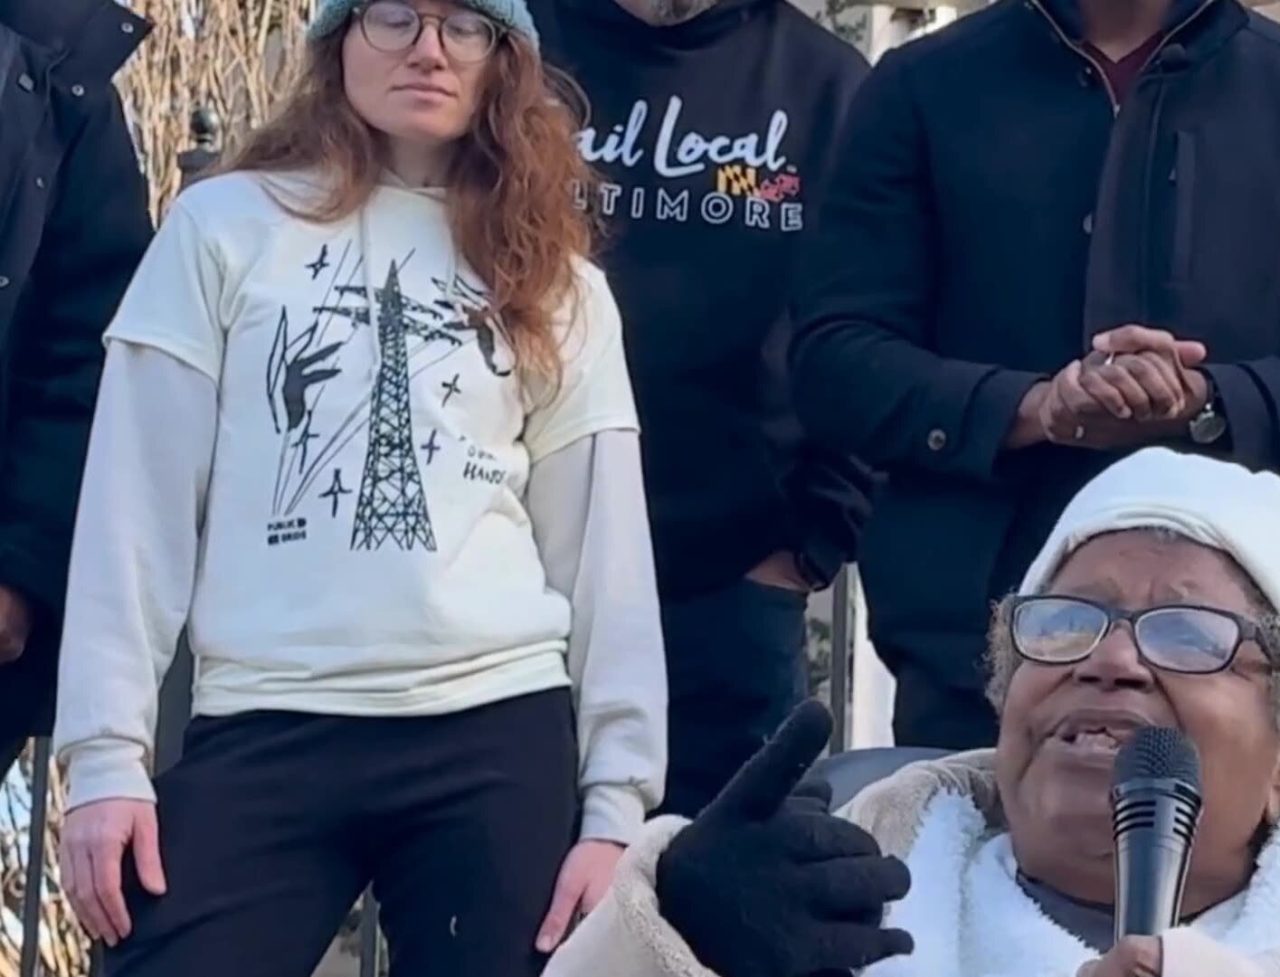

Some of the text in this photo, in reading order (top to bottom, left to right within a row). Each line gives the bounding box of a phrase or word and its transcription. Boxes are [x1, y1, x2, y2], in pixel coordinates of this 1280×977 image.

[572, 95, 788, 178] ail Local
[571, 178, 804, 232] LTIMORE
